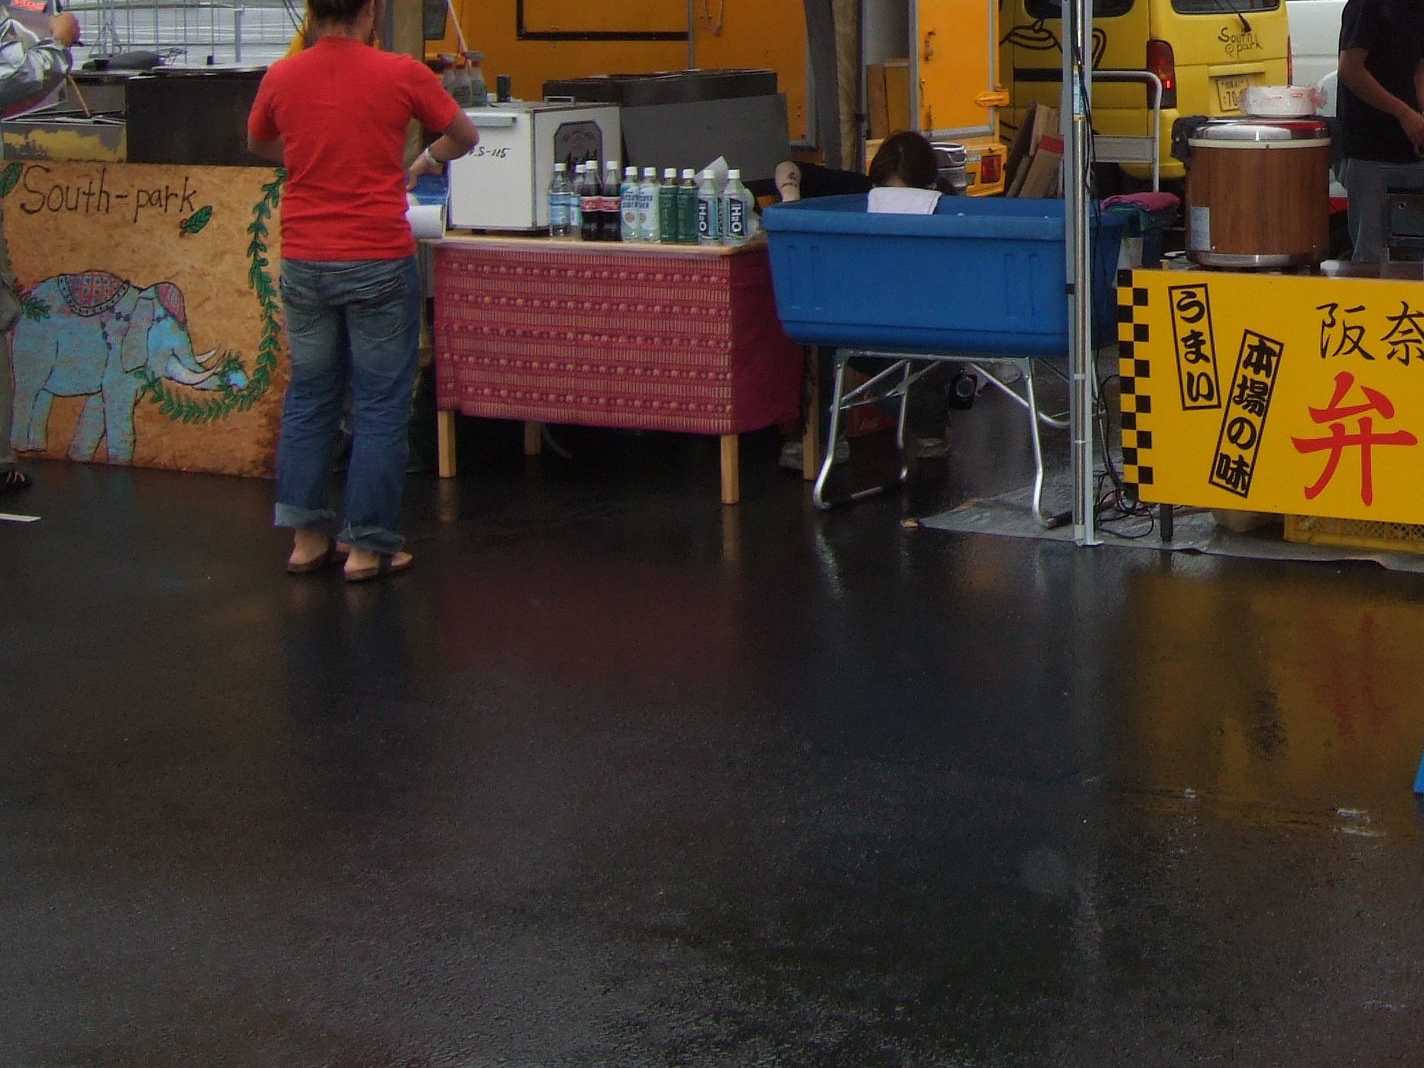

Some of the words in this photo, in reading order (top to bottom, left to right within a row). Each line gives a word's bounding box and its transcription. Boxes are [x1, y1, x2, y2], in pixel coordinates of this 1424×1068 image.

[1177, 290, 1215, 402] うまい
[1215, 338, 1277, 491] 本場の味
